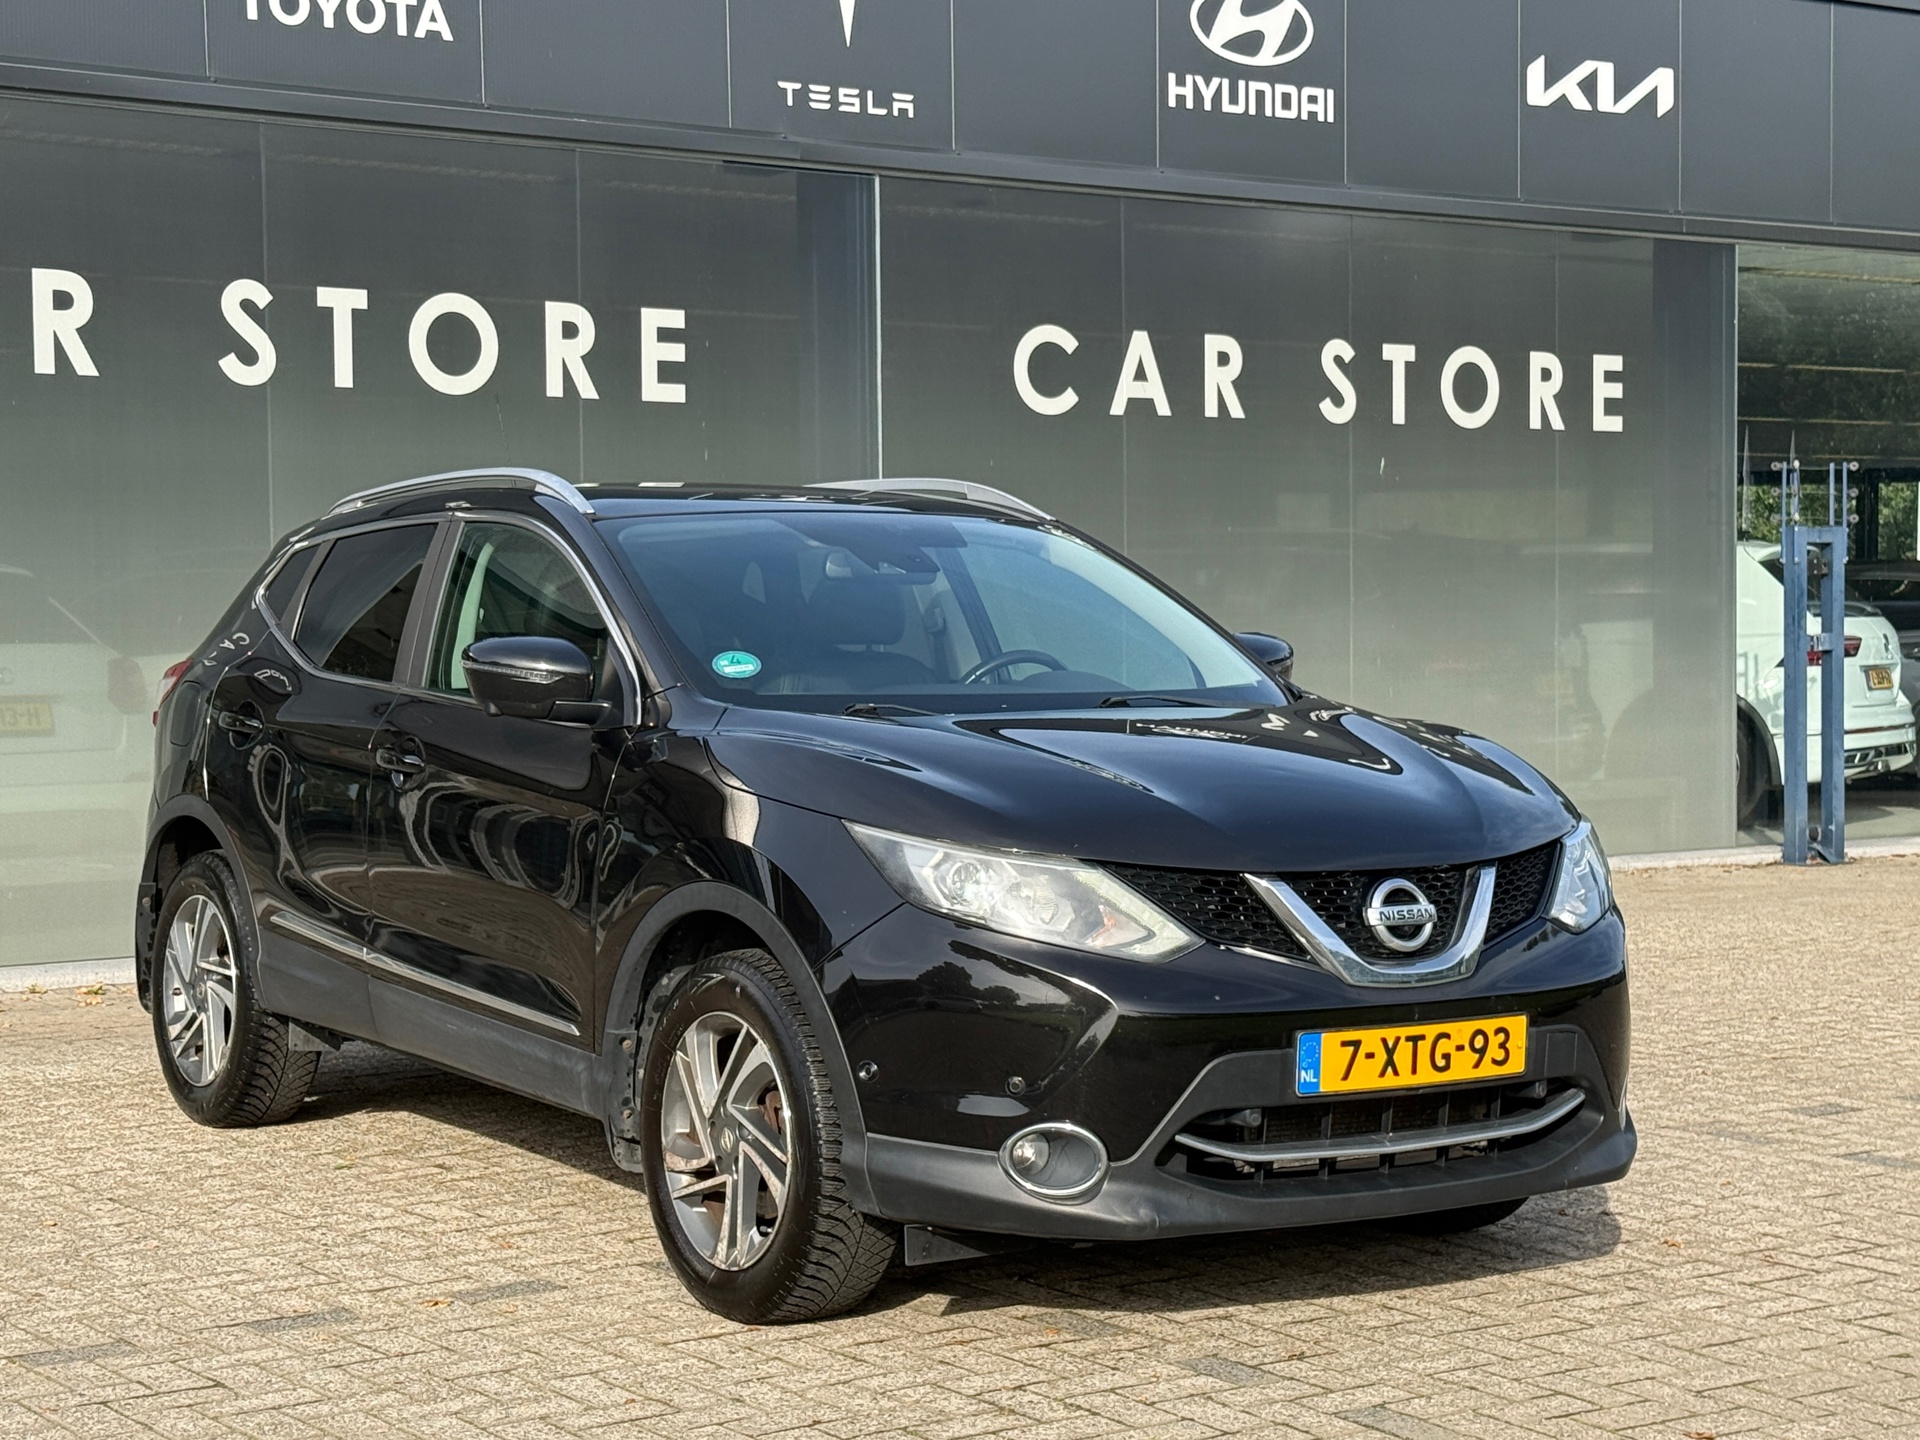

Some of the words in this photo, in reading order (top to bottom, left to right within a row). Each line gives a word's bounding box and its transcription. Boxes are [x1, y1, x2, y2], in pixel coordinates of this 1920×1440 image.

[777, 80, 914, 119] TESLA
[1167, 72, 1335, 123] HYUNDAI
[1526, 54, 1675, 118] KIA
[218, 278, 686, 404] STORE
[1013, 324, 1246, 419] CAR
[1318, 338, 1623, 433] STORE
[1379, 908, 1433, 922] NISSAN
[1301, 1069, 1318, 1083] NL
[1340, 1026, 1511, 1082] 7-XTG-93
